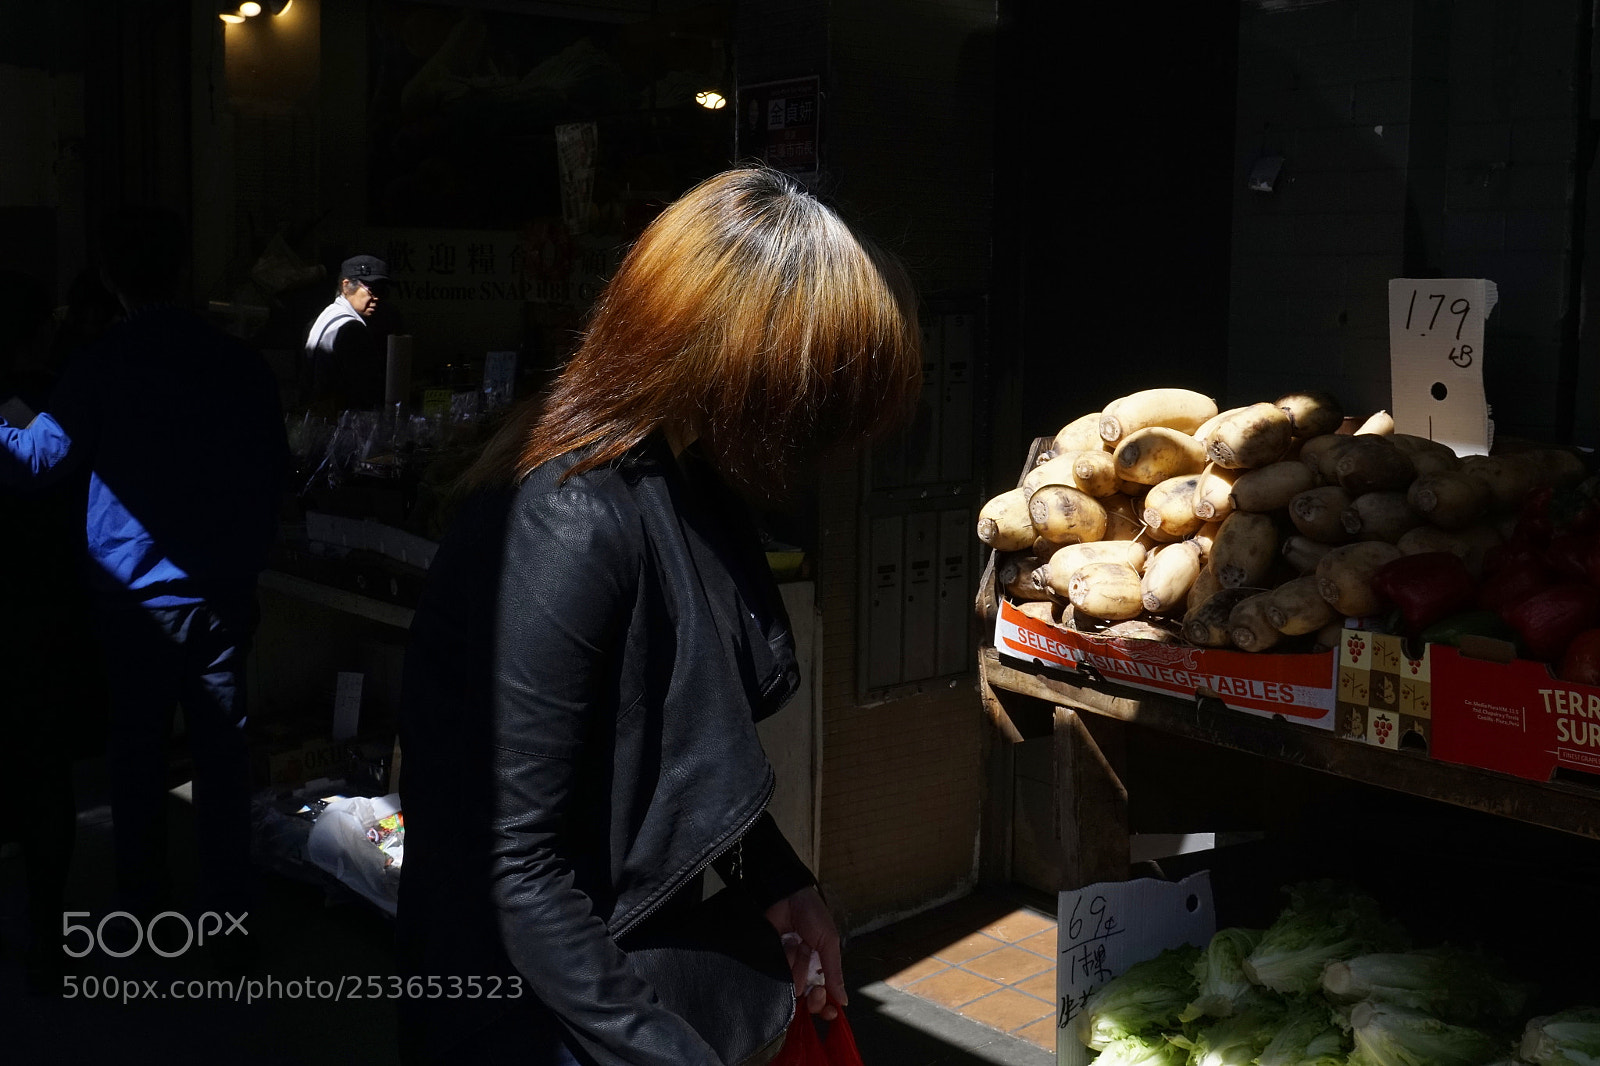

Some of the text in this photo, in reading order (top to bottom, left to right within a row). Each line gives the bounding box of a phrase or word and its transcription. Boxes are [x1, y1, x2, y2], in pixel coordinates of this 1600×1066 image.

[396, 280, 476, 301] Welcome
[480, 281, 533, 301] SNAP
[1017, 627, 1078, 662] SELECT
[1144, 664, 1295, 703] VEGETABLES
